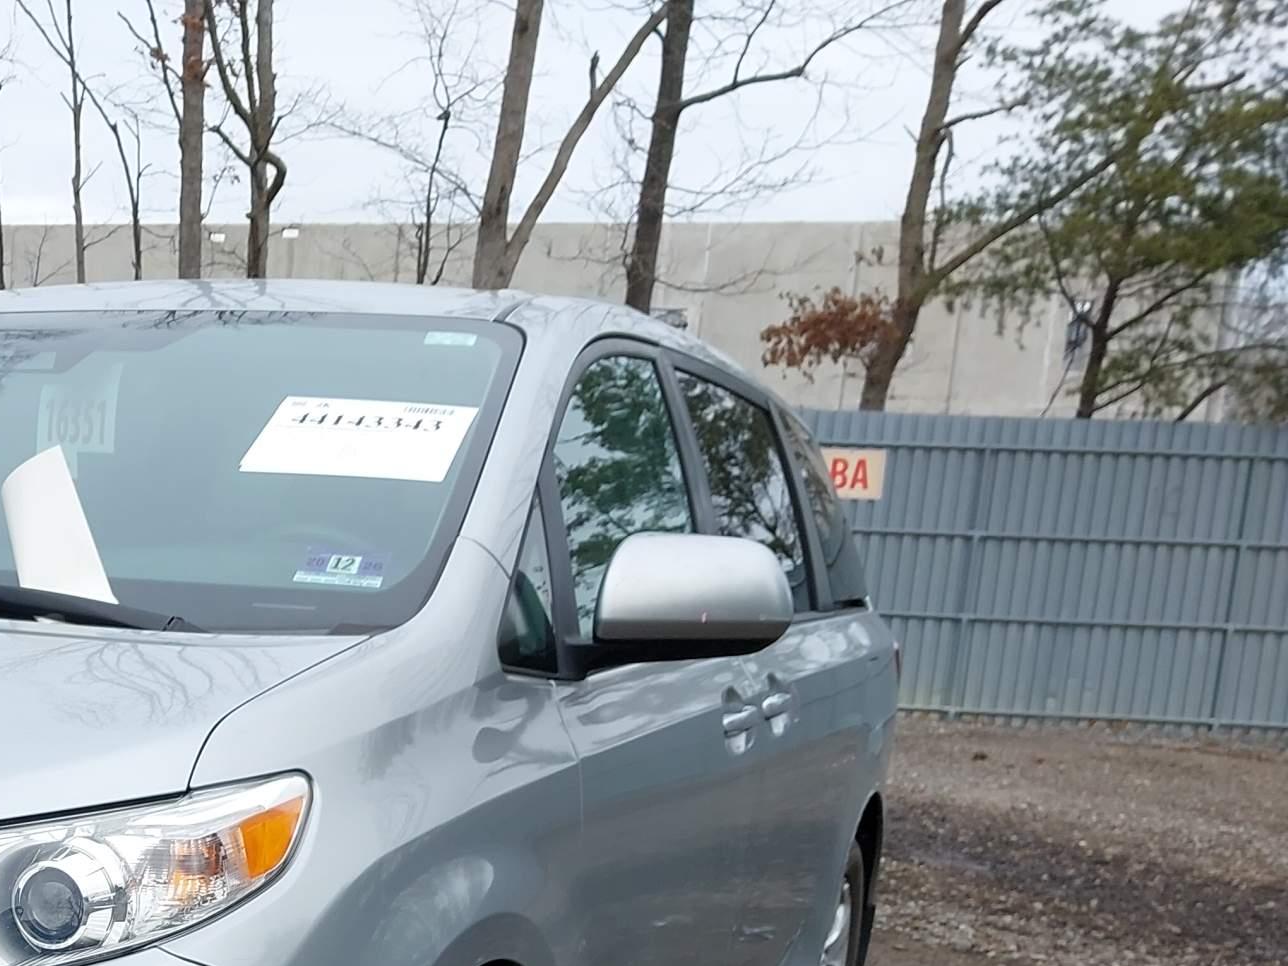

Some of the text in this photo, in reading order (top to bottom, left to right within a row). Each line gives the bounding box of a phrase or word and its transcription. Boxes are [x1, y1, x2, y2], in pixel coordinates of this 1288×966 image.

[291, 413, 443, 432] 44143343
[831, 458, 868, 489] BA
[332, 556, 356, 571] 12
